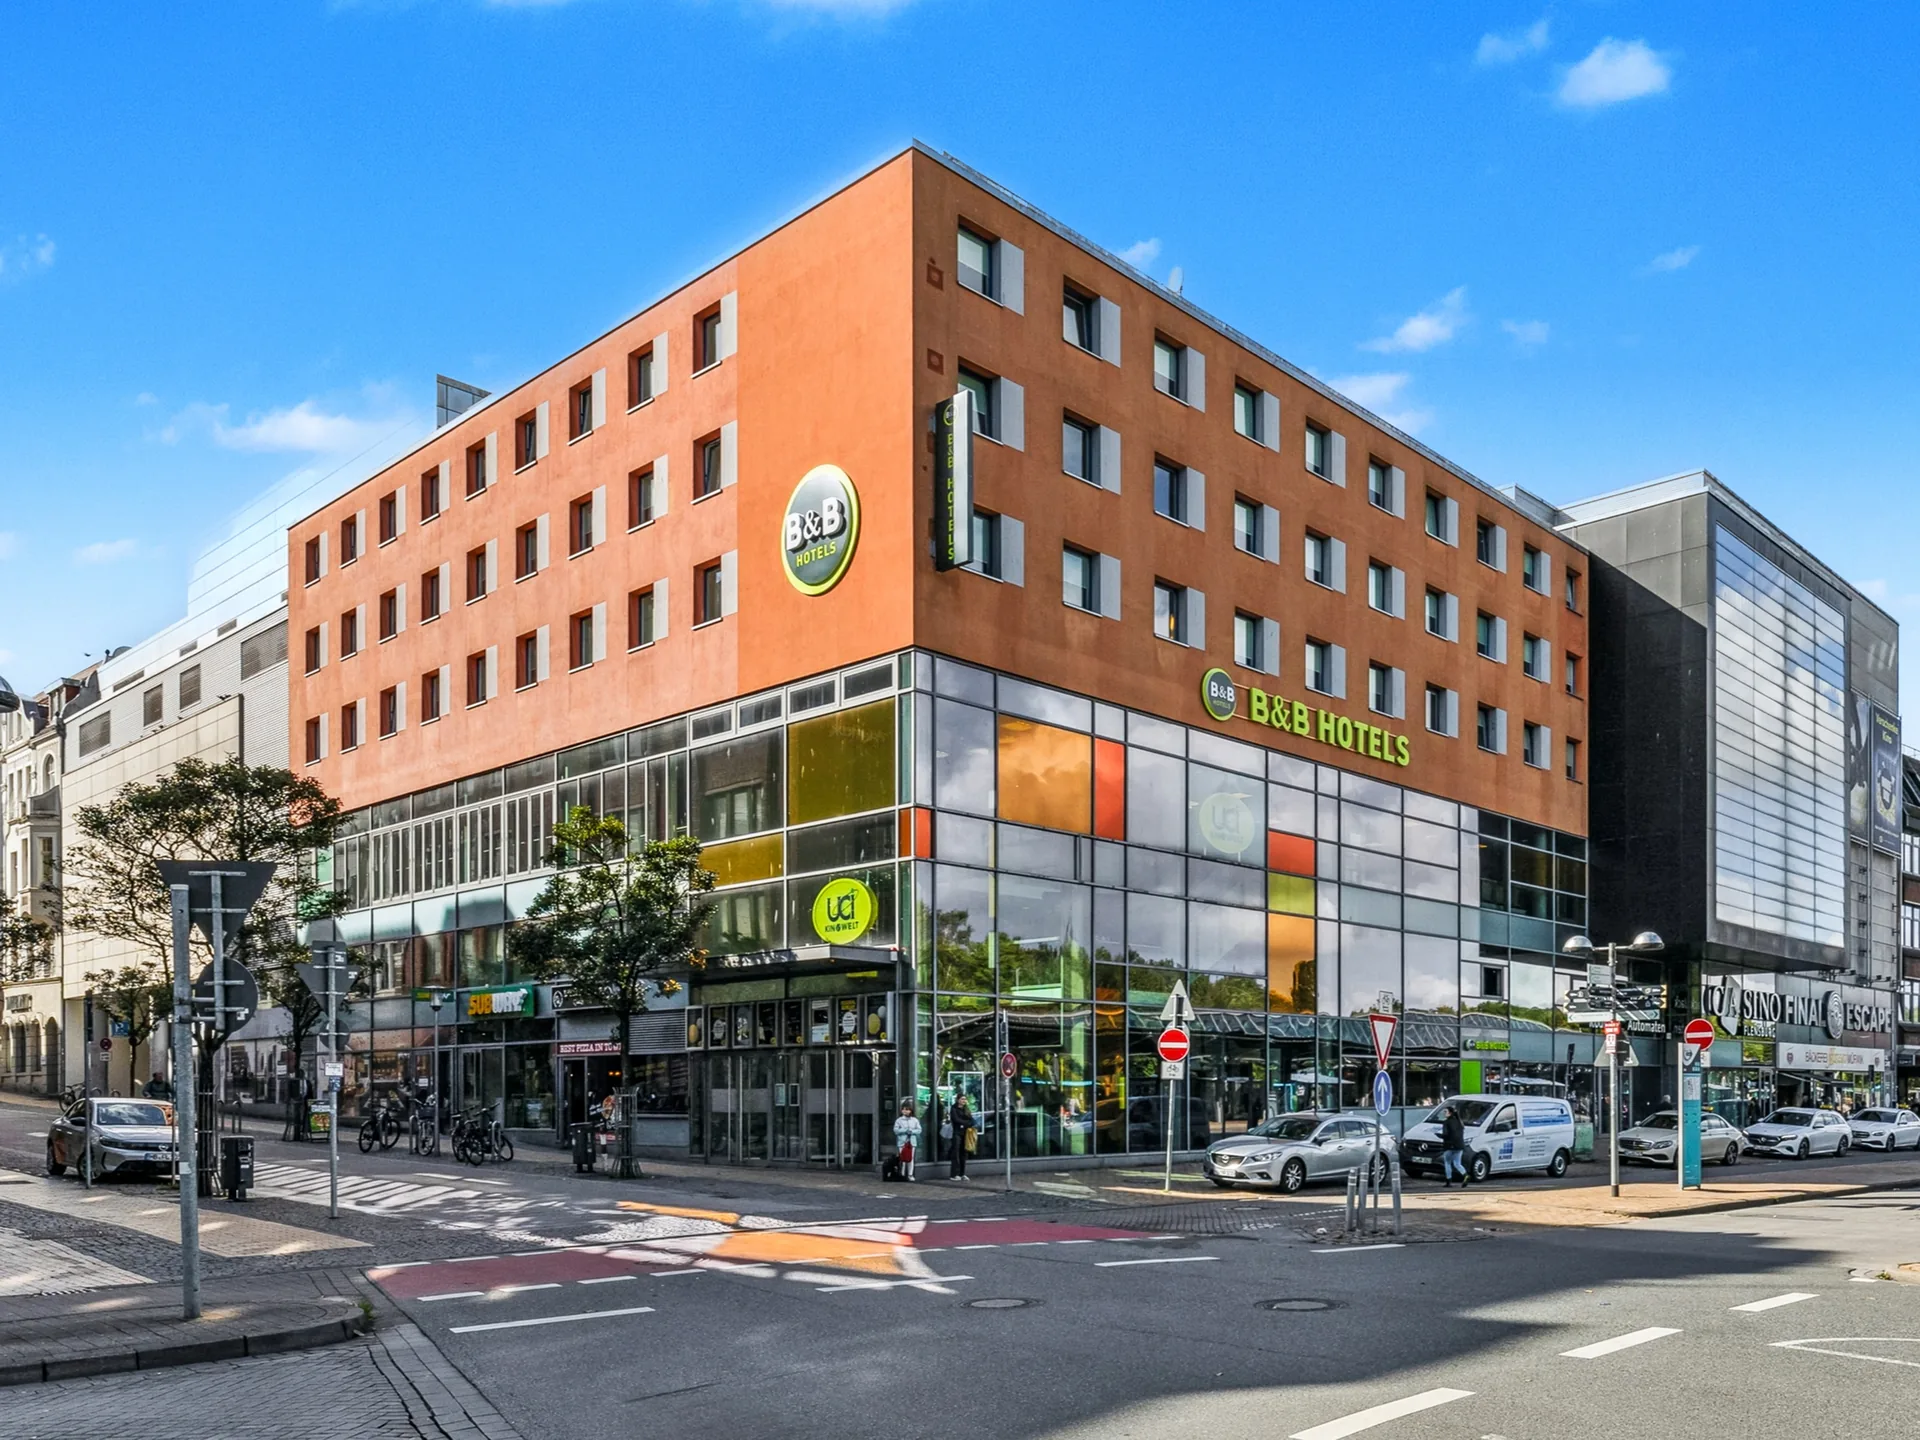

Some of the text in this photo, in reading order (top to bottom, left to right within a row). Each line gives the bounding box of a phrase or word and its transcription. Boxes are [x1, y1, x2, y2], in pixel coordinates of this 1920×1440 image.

[786, 497, 846, 553] B&B
[796, 541, 837, 567] HOTELS
[1210, 681, 1235, 703] B&B
[1249, 687, 1410, 767] B&B HOTELS
[467, 988, 529, 1016] SUBWAY
[1785, 995, 1893, 1033] FINAL ESCAPE
[1627, 1020, 1666, 1033] Automaten
[560, 1044, 576, 1053] BEST
[576, 1043, 595, 1052] PIZZA
[595, 1042, 604, 1052] IN
